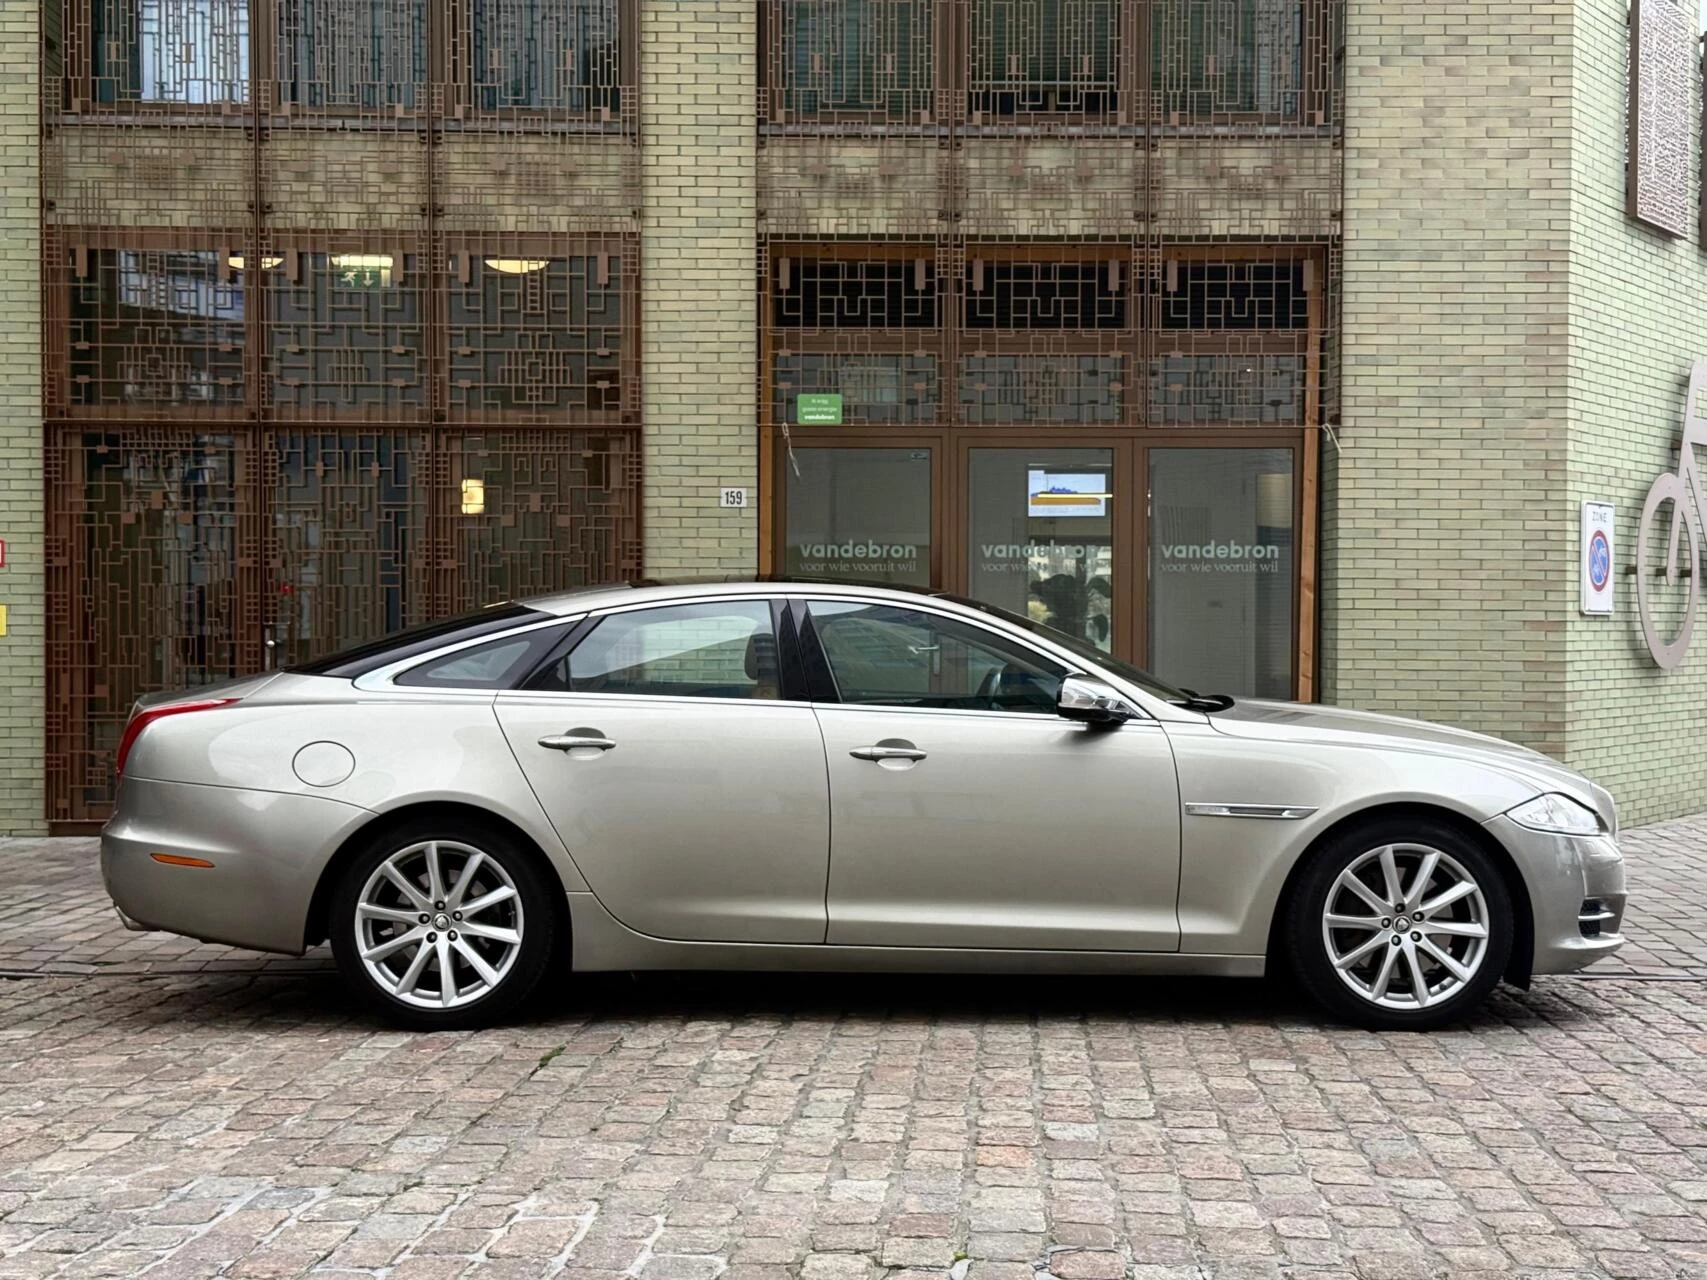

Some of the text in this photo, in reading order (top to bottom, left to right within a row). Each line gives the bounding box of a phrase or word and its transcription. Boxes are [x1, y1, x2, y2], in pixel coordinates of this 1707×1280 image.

[725, 490, 743, 505] 159
[1592, 511, 1608, 523] ZONE
[800, 539, 917, 558] vandebron
[1161, 539, 1279, 558] vandebron
[800, 560, 916, 572] voor wie vooruit wil
[982, 562, 1009, 572] voor
[1161, 560, 1279, 573] voor wie vooruit wil
